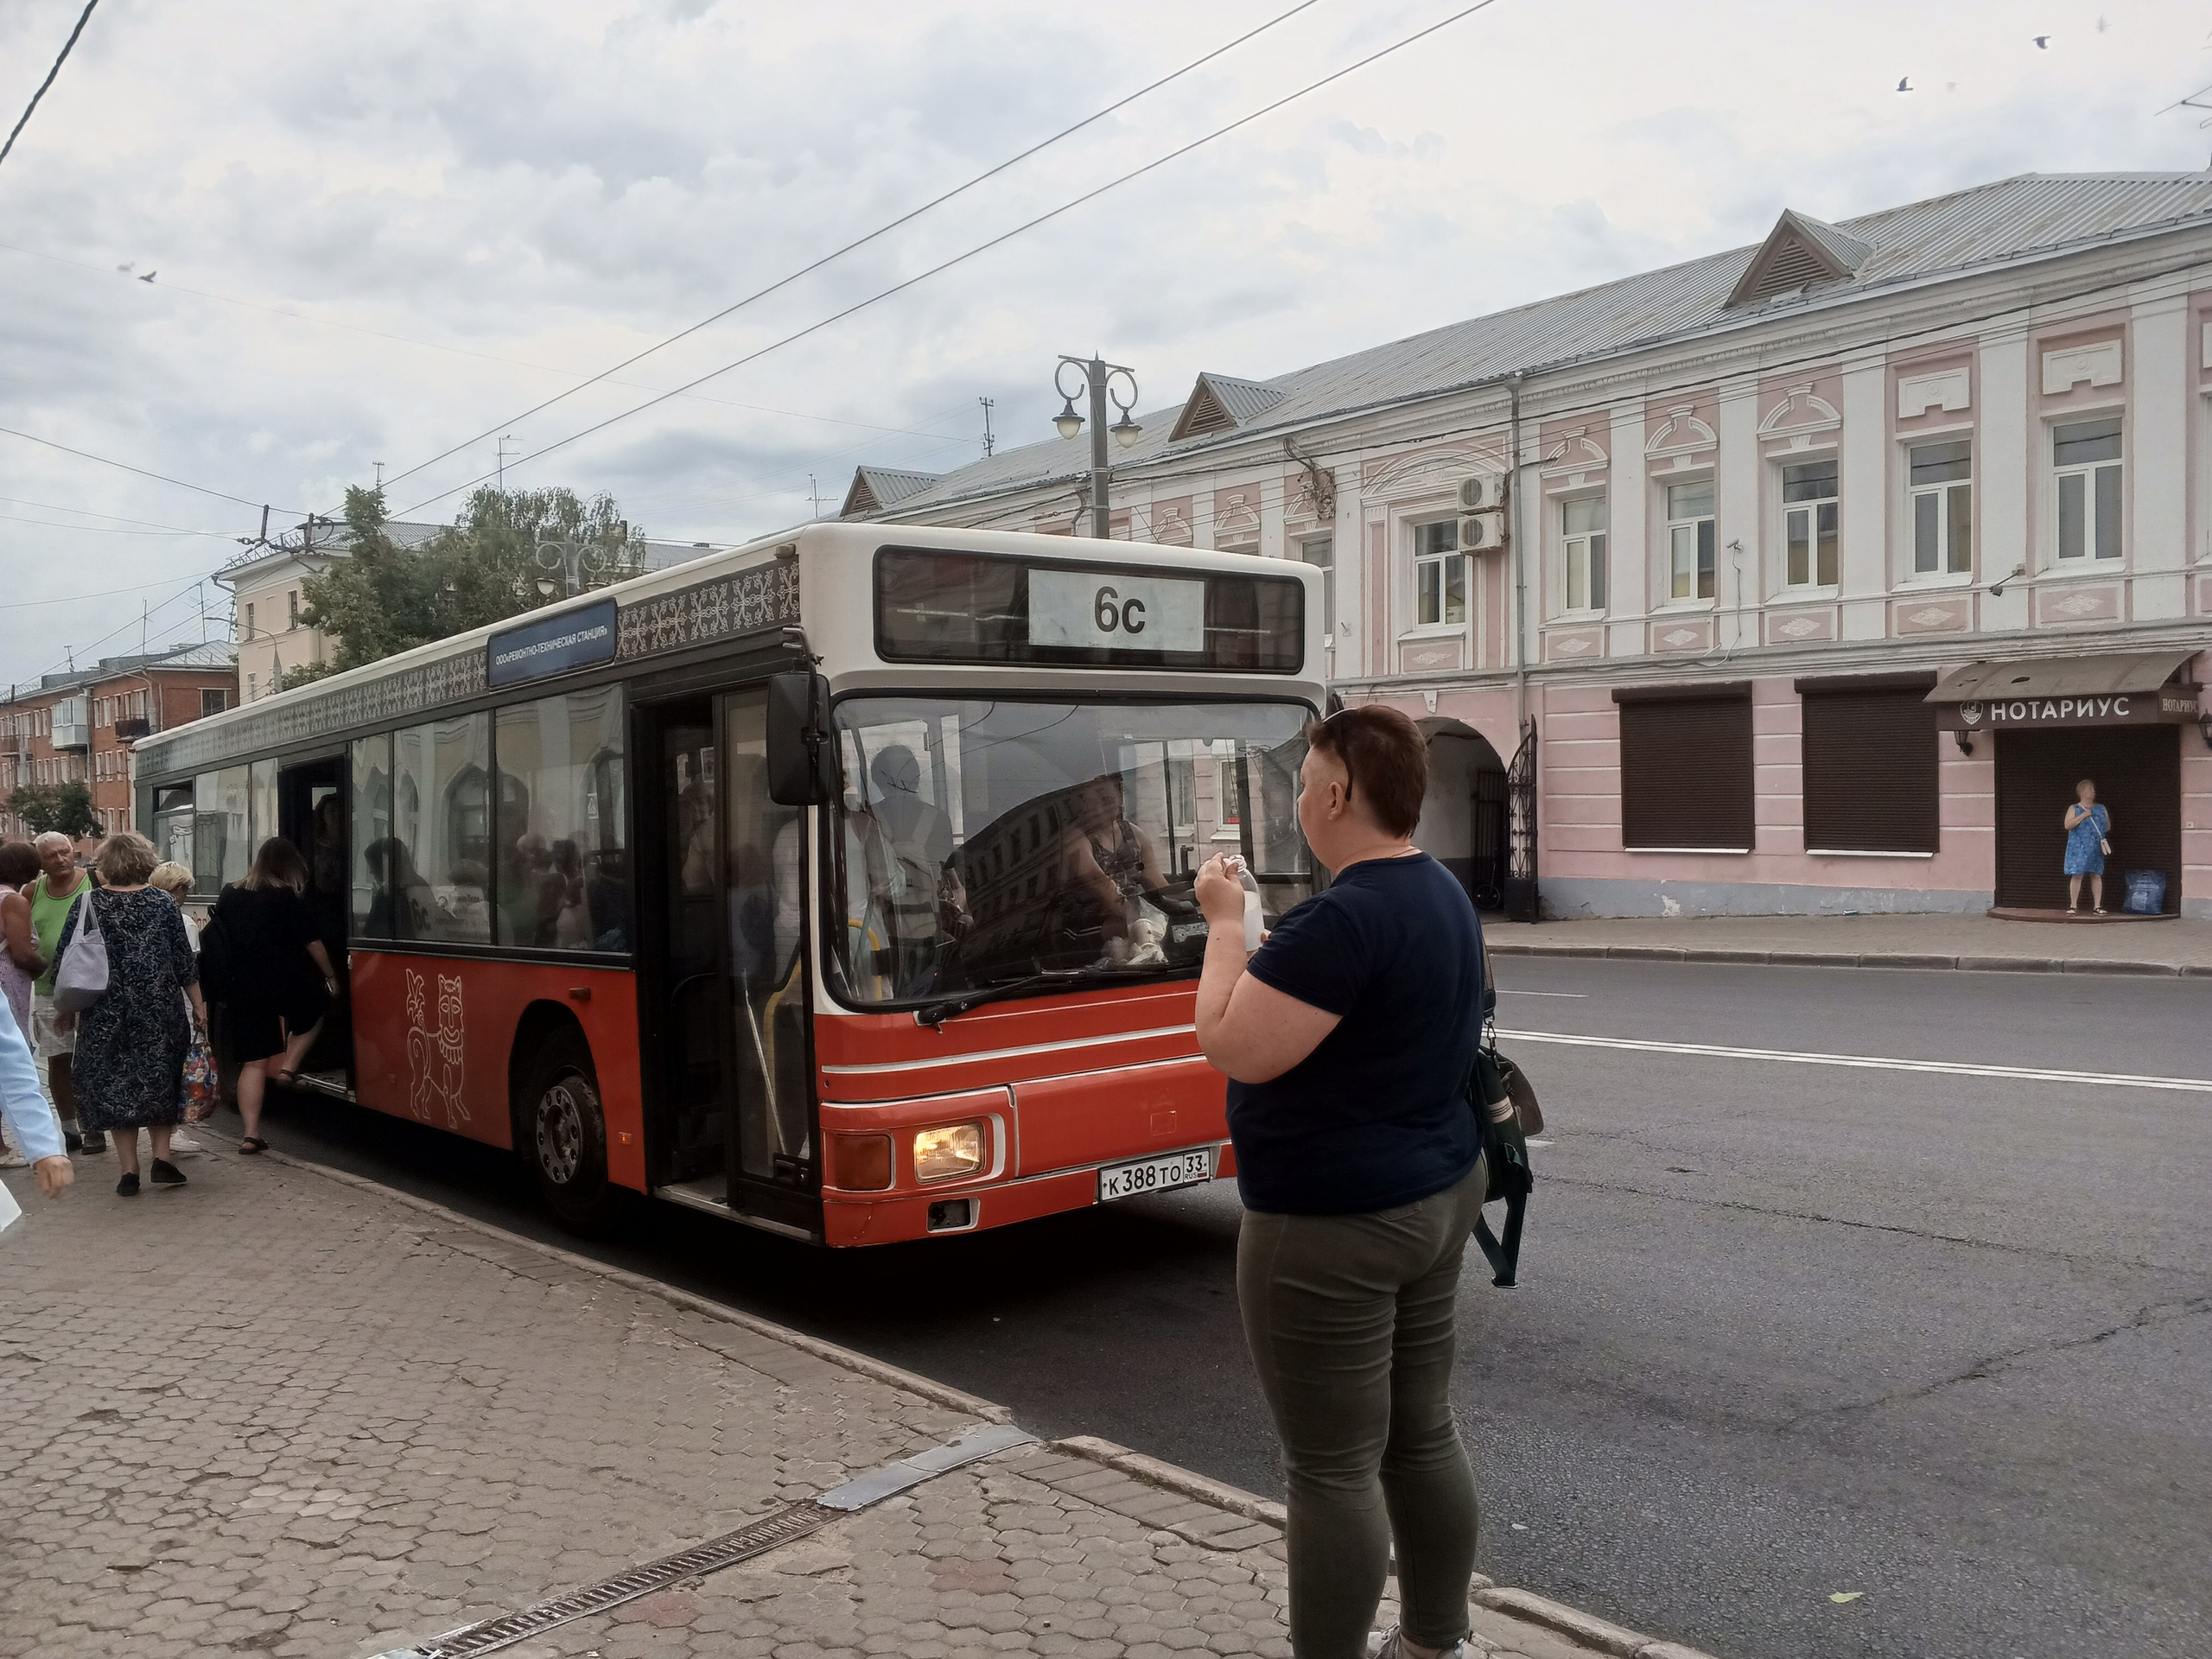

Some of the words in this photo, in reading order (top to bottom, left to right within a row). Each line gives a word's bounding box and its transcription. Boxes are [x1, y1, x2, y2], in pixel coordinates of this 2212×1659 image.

[1094, 586, 1146, 634] 6с
[576, 625, 608, 644] СТАНЦИЯ»
[1990, 696, 2130, 721] НОТАРИУС
[2162, 697, 2198, 713] НОТАРИУС
[1185, 1172, 1198, 1180] RUS
